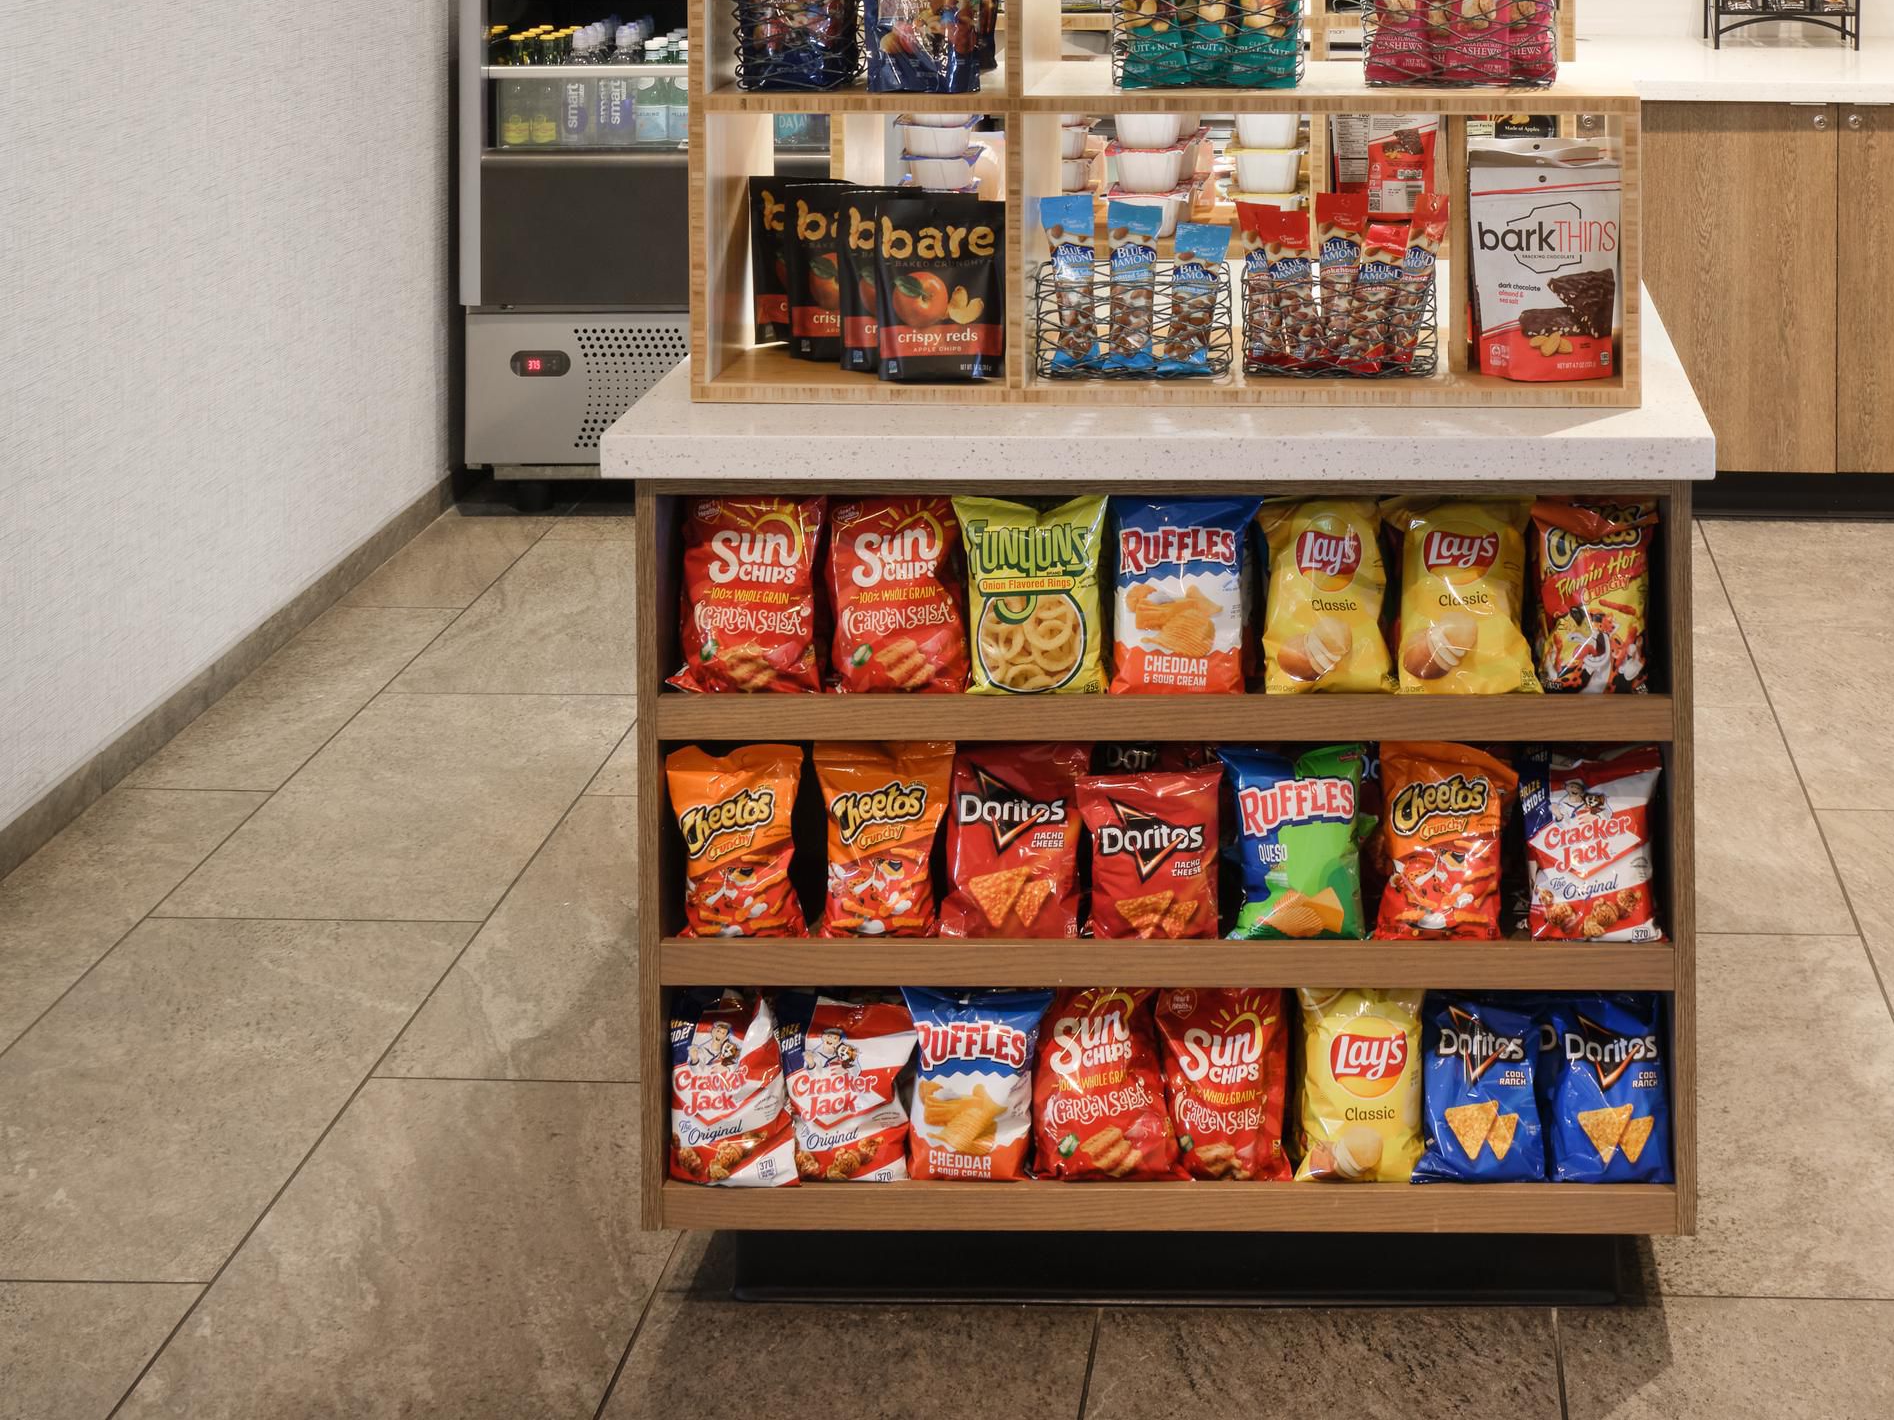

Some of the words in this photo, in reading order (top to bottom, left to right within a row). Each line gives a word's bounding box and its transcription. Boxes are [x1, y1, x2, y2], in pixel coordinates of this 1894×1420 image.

[1376, 41, 1423, 51] CASHEWS
[567, 83, 579, 128] smart
[610, 79, 621, 125] smart
[881, 215, 996, 260] bare
[1323, 240, 1349, 254] BLUE
[1058, 245, 1084, 256] BLUE
[1110, 251, 1157, 268] DIAMOND
[1117, 245, 1144, 259] BLUE
[1276, 258, 1301, 272] BLUE
[1365, 263, 1391, 275] BLUE
[1498, 289, 1518, 298] almond
[1512, 283, 1541, 292] chocolate
[897, 330, 942, 349] crispy
[945, 327, 979, 342] reds
[912, 345, 937, 353] APPLE
[938, 344, 962, 352] CHIPS
[708, 528, 801, 584] Sun
[851, 527, 942, 588] Sun
[967, 519, 1091, 579] FUNYUNS
[1121, 528, 1236, 573] RUFFLES
[1300, 530, 1360, 577] Lay's
[1427, 530, 1499, 575] Lay's
[738, 565, 797, 584] CHIPS
[883, 561, 937, 581] CHIPS
[1555, 562, 1606, 605] Flamin'
[1607, 551, 1640, 575] Hot
[982, 578, 1007, 590] Onion
[1008, 577, 1045, 590] Flavored
[1047, 577, 1072, 590] Rings
[1582, 574, 1632, 604] Crunchy
[710, 589, 733, 600] 100%
[734, 589, 762, 602] WHOLE
[762, 591, 790, 605] GRAIN
[858, 590, 881, 604] 100%
[881, 588, 909, 602] WHOLE
[908, 586, 936, 600] GRAIN
[1311, 598, 1358, 613] Classic
[1438, 592, 1489, 607] Classic
[1143, 654, 1208, 675] CHEDDAR
[1143, 673, 1150, 683] &
[1152, 674, 1175, 685] SOUR
[1176, 675, 1206, 687] CREAM
[831, 782, 925, 843] Cheetos
[959, 794, 1065, 823] Doritos
[1239, 779, 1355, 836] RUFFLES
[1392, 777, 1487, 836] Cheetos
[681, 789, 773, 858] Cheetos
[1420, 817, 1467, 841] Crunchy
[1543, 816, 1632, 851] Cracker
[706, 832, 754, 861] Crunchy
[857, 823, 904, 849] Crunchy
[1031, 840, 1064, 848] CHEESE
[1033, 832, 1064, 840] NACHO
[1101, 825, 1203, 854] Doritos
[1258, 843, 1288, 863] QUESO
[1555, 839, 1610, 873] Jack
[1171, 867, 1202, 876] CHEESE
[1174, 859, 1201, 869] NACHO
[1550, 876, 1566, 891] The
[1634, 929, 1649, 939] 370
[914, 1023, 1026, 1068] RUFFLES
[1050, 1010, 1131, 1074] Sun
[1439, 1028, 1525, 1060] Doritos
[1565, 1033, 1658, 1063] Doritos
[1083, 1040, 1133, 1068] CHIPS
[1179, 1027, 1264, 1082] Sun
[1334, 1033, 1406, 1082] Lay's
[791, 1072, 877, 1095] Cracker
[1081, 1072, 1109, 1088] WHOLE
[1208, 1062, 1260, 1085] CHIPS
[1499, 1078, 1527, 1086] RANCH
[1505, 1070, 1525, 1079] COOL
[1632, 1079, 1659, 1088] RANCH
[1638, 1071, 1657, 1079] COOL
[683, 1091, 738, 1117] Jack
[1202, 1089, 1230, 1105] WHOLE
[1230, 1089, 1256, 1105] GRAIN
[801, 1094, 857, 1123] Jack
[1344, 1106, 1396, 1121] Classic
[679, 1120, 692, 1133] The
[688, 1120, 743, 1146] Original
[806, 1129, 858, 1151] Original
[758, 1159, 774, 1170] 370
[929, 1149, 992, 1170] CHEDDAR
[877, 1171, 893, 1181] 370
[929, 1165, 935, 1174] &
[937, 1168, 960, 1178] SOUR
[961, 1168, 992, 1178] CREAM
